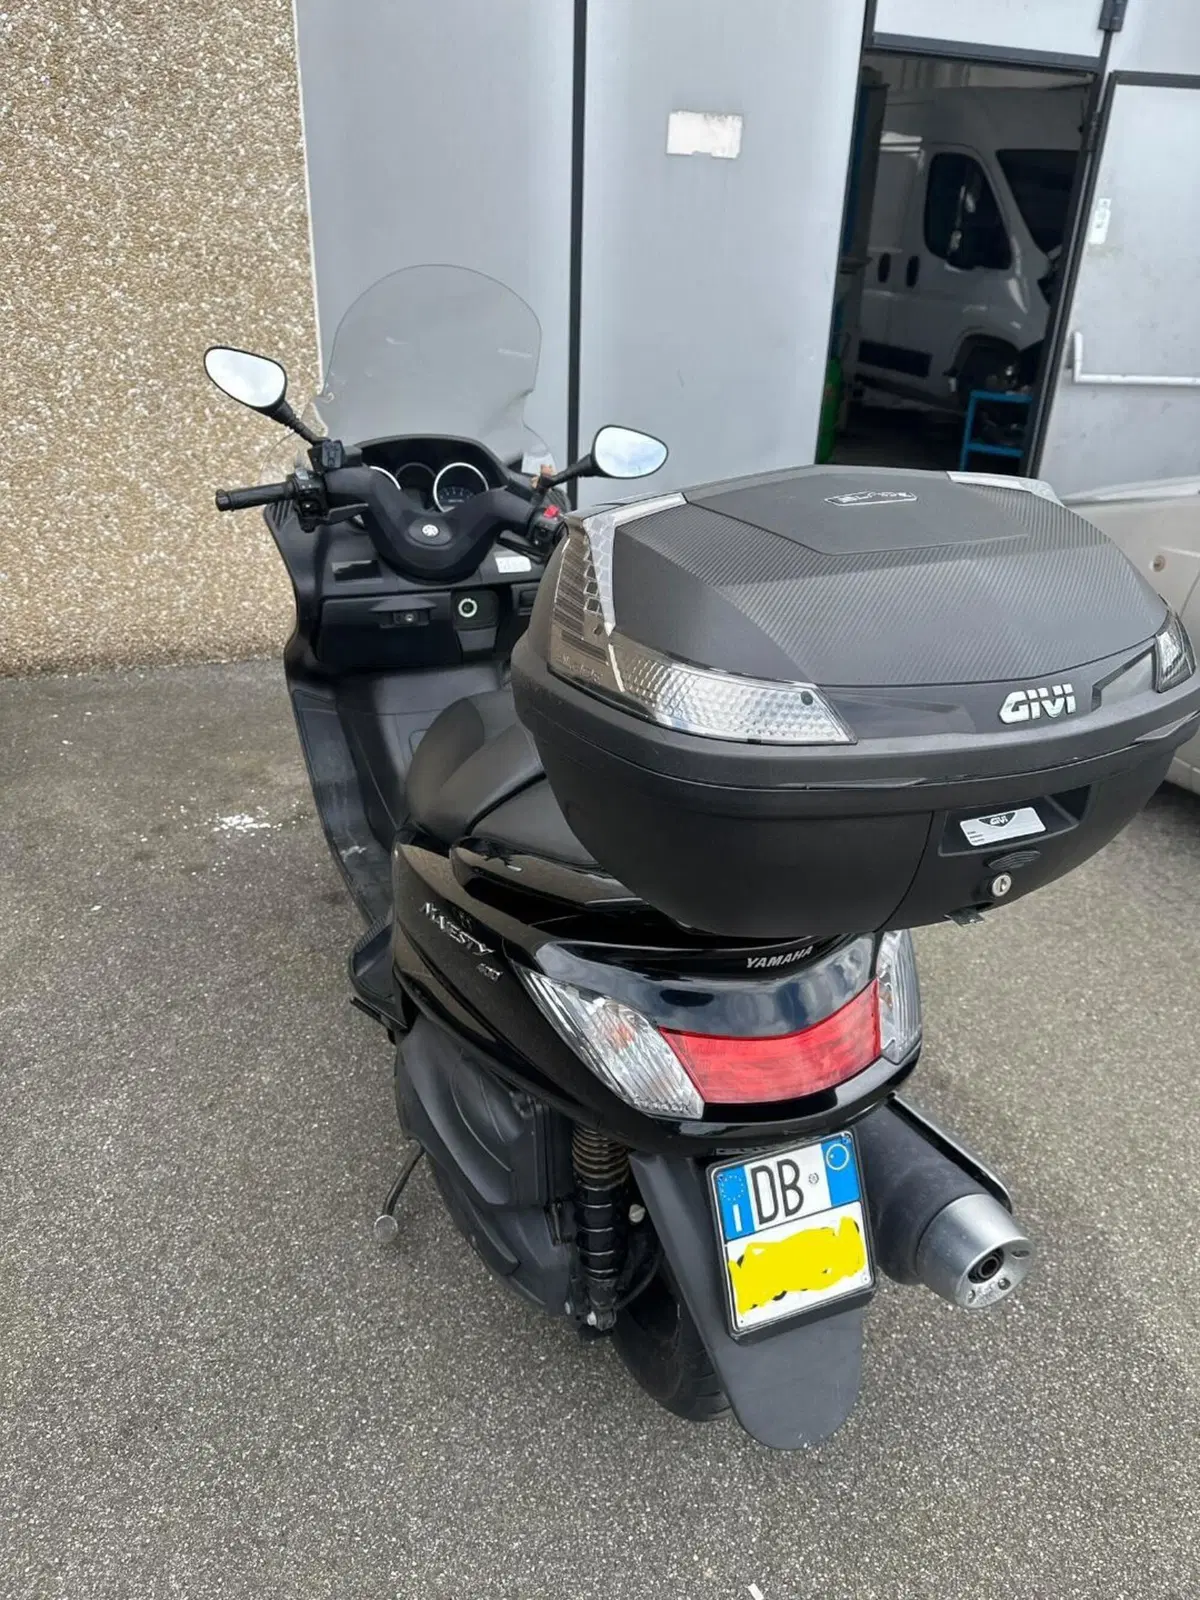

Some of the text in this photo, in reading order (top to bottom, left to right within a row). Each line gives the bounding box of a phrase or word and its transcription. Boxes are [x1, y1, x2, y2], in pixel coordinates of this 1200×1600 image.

[999, 684, 1076, 723] GIVI
[990, 816, 1008, 825] GIVI
[747, 946, 813, 968] YAMAHA
[751, 1158, 804, 1225] DB
[733, 1204, 742, 1232] I
